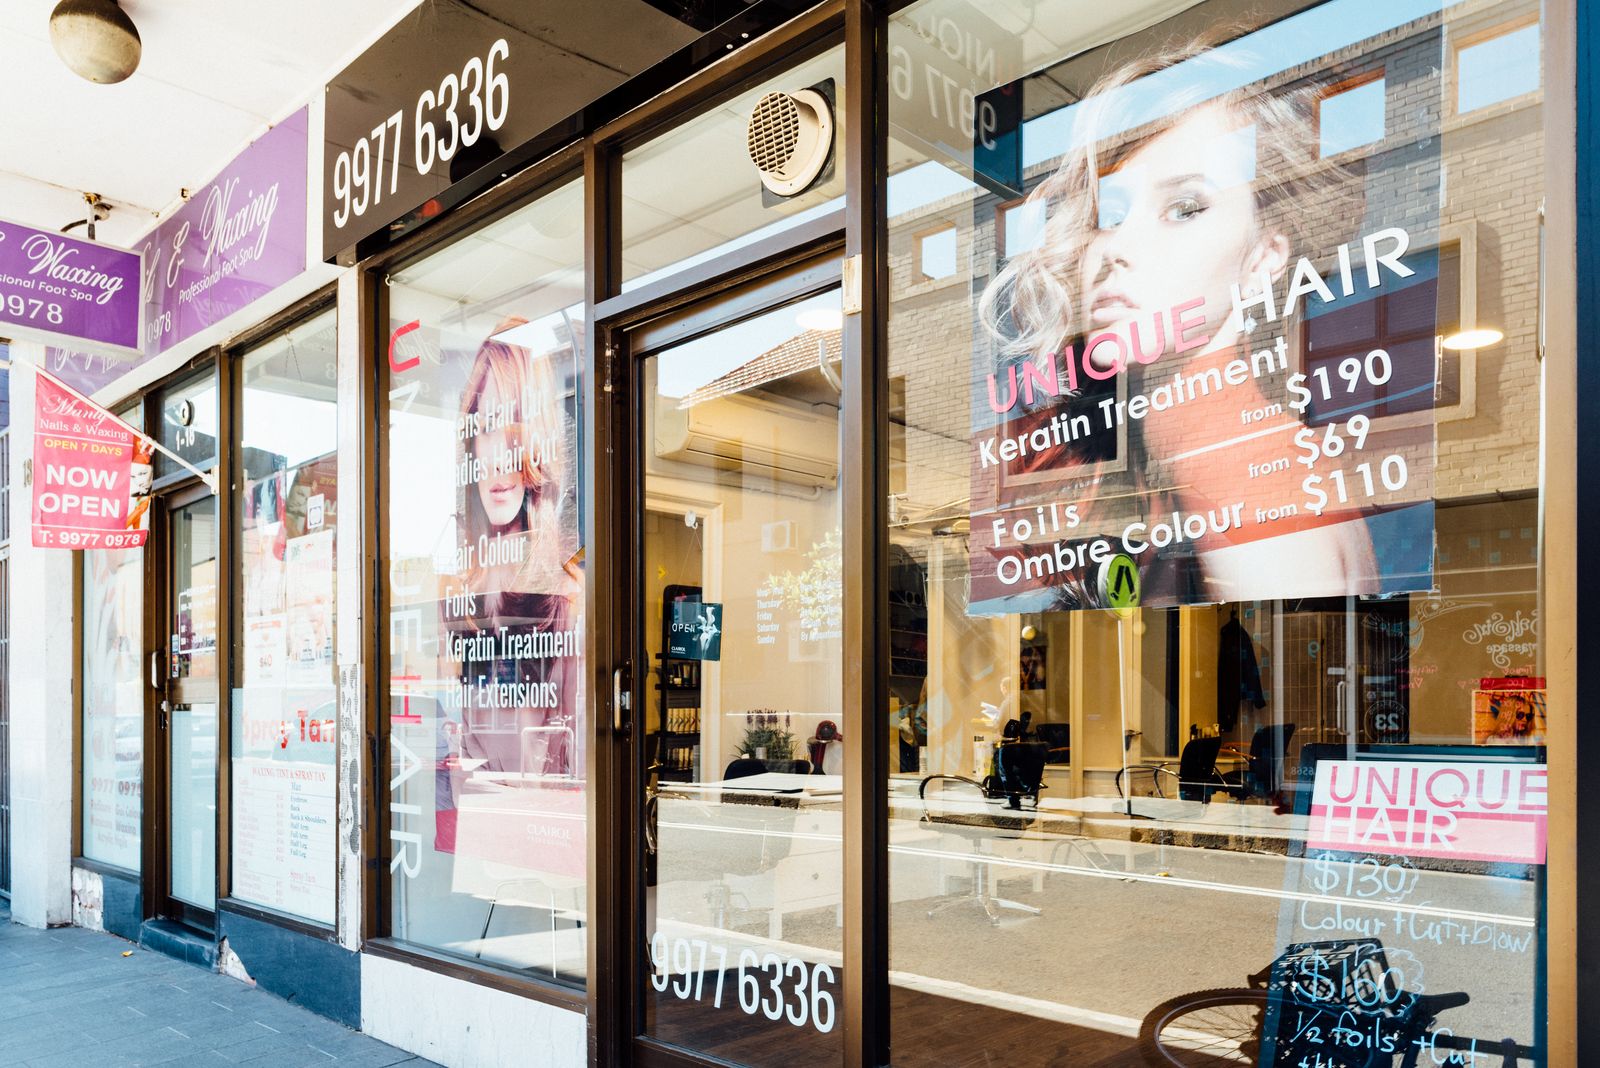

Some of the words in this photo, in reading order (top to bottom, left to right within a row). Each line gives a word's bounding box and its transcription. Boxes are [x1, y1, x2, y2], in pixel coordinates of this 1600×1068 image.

[333, 109, 403, 229] 9977
[415, 38, 510, 176] 6336
[199, 176, 279, 268] Waxing
[21, 233, 123, 304] Waxing
[38, 281, 67, 296] Foot
[69, 288, 93, 301] Spa
[178, 266, 221, 304] Professional
[222, 259, 239, 277] Foot
[239, 247, 254, 269] Spa
[987, 297, 1210, 413] UNIQUE
[1230, 227, 1416, 334] HAIR
[979, 411, 1091, 469] Keratin
[1098, 336, 1290, 432] Treatment
[1241, 400, 1283, 425] from
[1286, 349, 1393, 414] $190
[39, 418, 69, 433] Nails
[73, 423, 82, 433] &
[86, 425, 129, 442] Waxing
[457, 411, 480, 440] ens
[486, 398, 516, 433] Hair
[44, 438, 78, 451] OPEN
[81, 443, 88, 451] 7
[91, 444, 122, 457] DAYS
[455, 452, 489, 487] adies
[494, 439, 525, 474] Hair
[530, 430, 558, 467] Cut
[46, 464, 119, 491] NOW
[992, 502, 1080, 547] Foils
[1248, 455, 1290, 480] from
[1293, 414, 1371, 469] $69
[38, 492, 120, 519] OPEN
[997, 534, 1111, 586] Ombre
[1122, 501, 1247, 555] Colour
[1255, 500, 1298, 524] from
[1302, 454, 1408, 516] $110
[39, 530, 53, 544] T:
[59, 532, 99, 546] 9977
[105, 533, 140, 546] 0978
[456, 541, 474, 570] air
[478, 531, 527, 569] Colour
[445, 584, 477, 618] Foils
[445, 631, 495, 664] Keratin
[499, 617, 581, 660] Treatment
[672, 623, 696, 633] OPEN
[478, 675, 558, 709] Extensions
[297, 709, 335, 743] Tan
[389, 675, 422, 879] HAIR
[1329, 765, 1547, 811] UNIQUE
[1323, 803, 1458, 851] HAIR
[1314, 850, 1407, 896] $130
[1300, 900, 1386, 935] Colour
[651, 931, 727, 1009] 9977
[738, 949, 835, 1034] 6336
[1298, 949, 1405, 1007] $160
